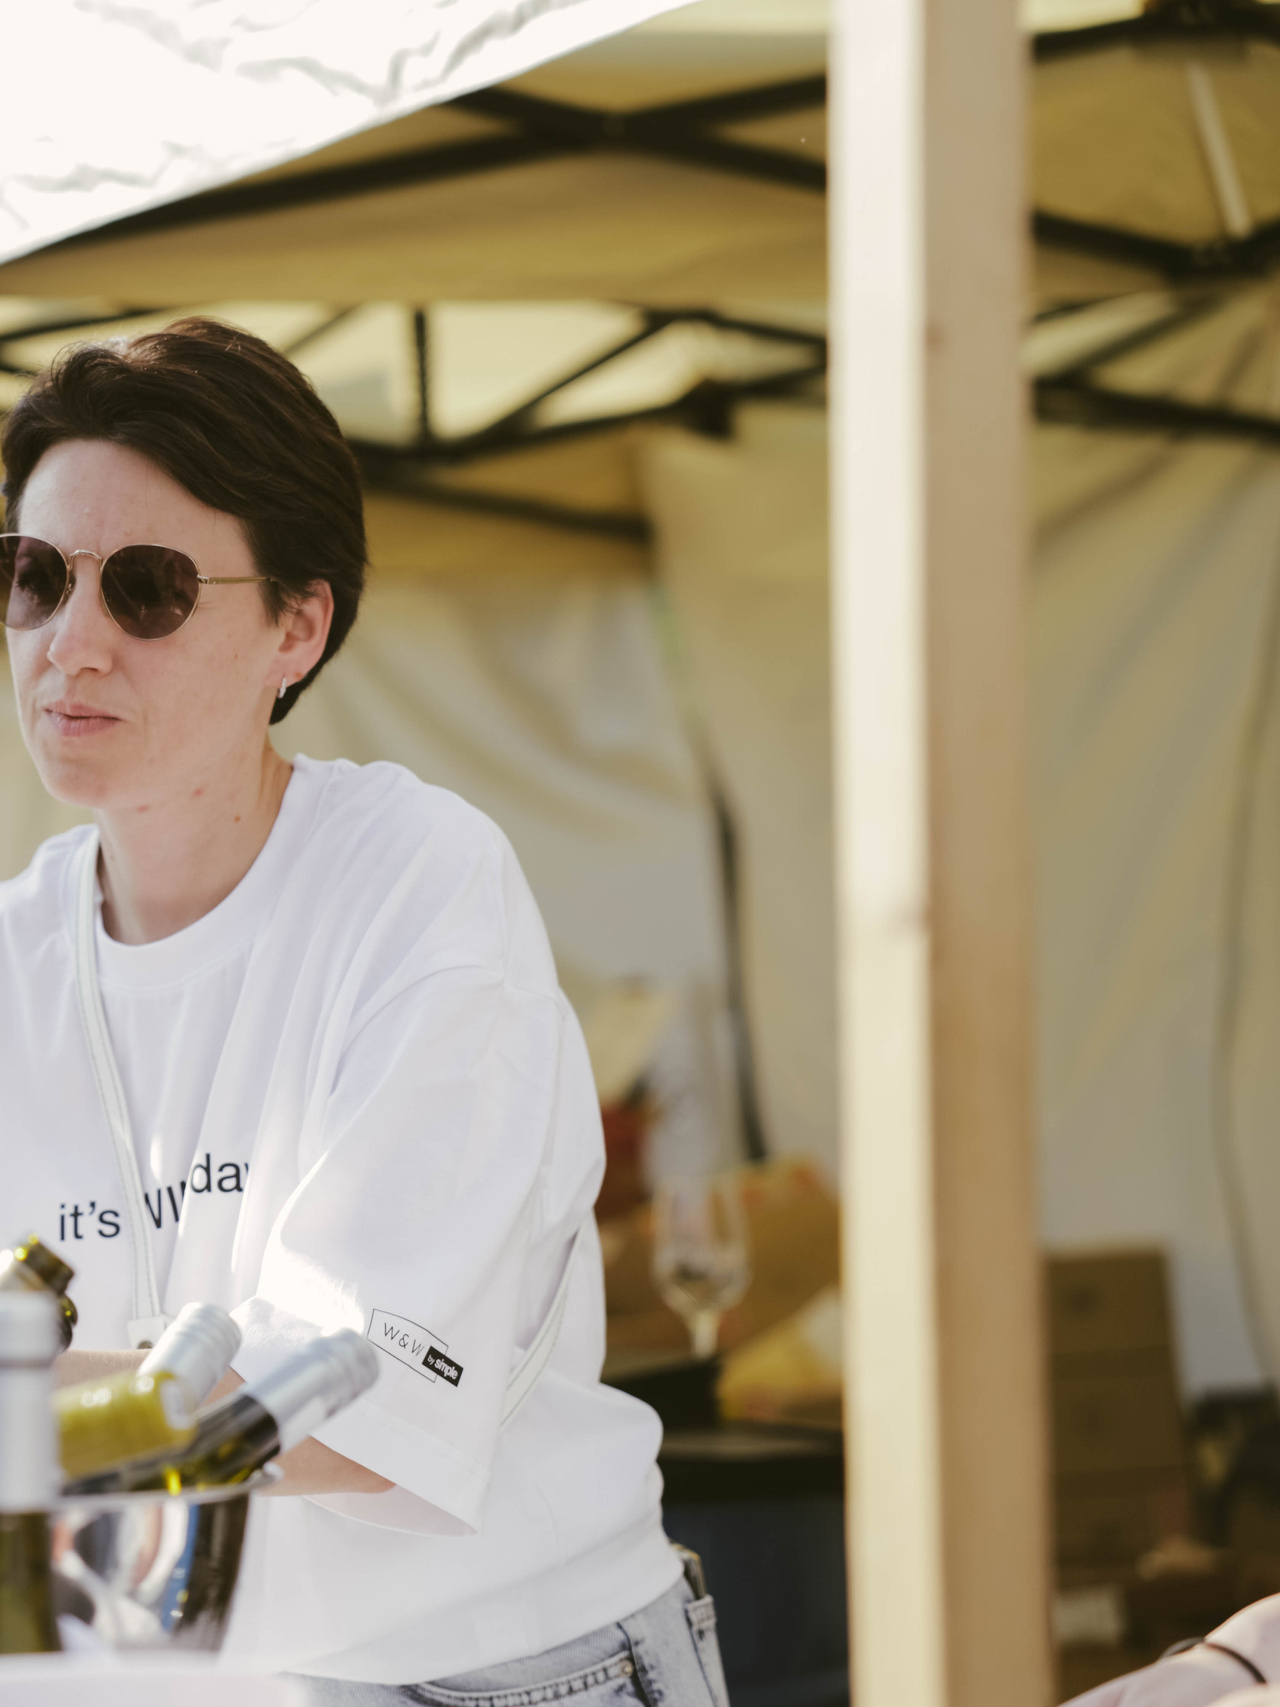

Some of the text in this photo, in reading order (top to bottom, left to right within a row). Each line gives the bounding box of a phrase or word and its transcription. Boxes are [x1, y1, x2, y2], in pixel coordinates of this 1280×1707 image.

[190, 1153, 250, 1193] da
[384, 1322, 425, 1356] W&W
[427, 1354, 458, 1380] by simple
